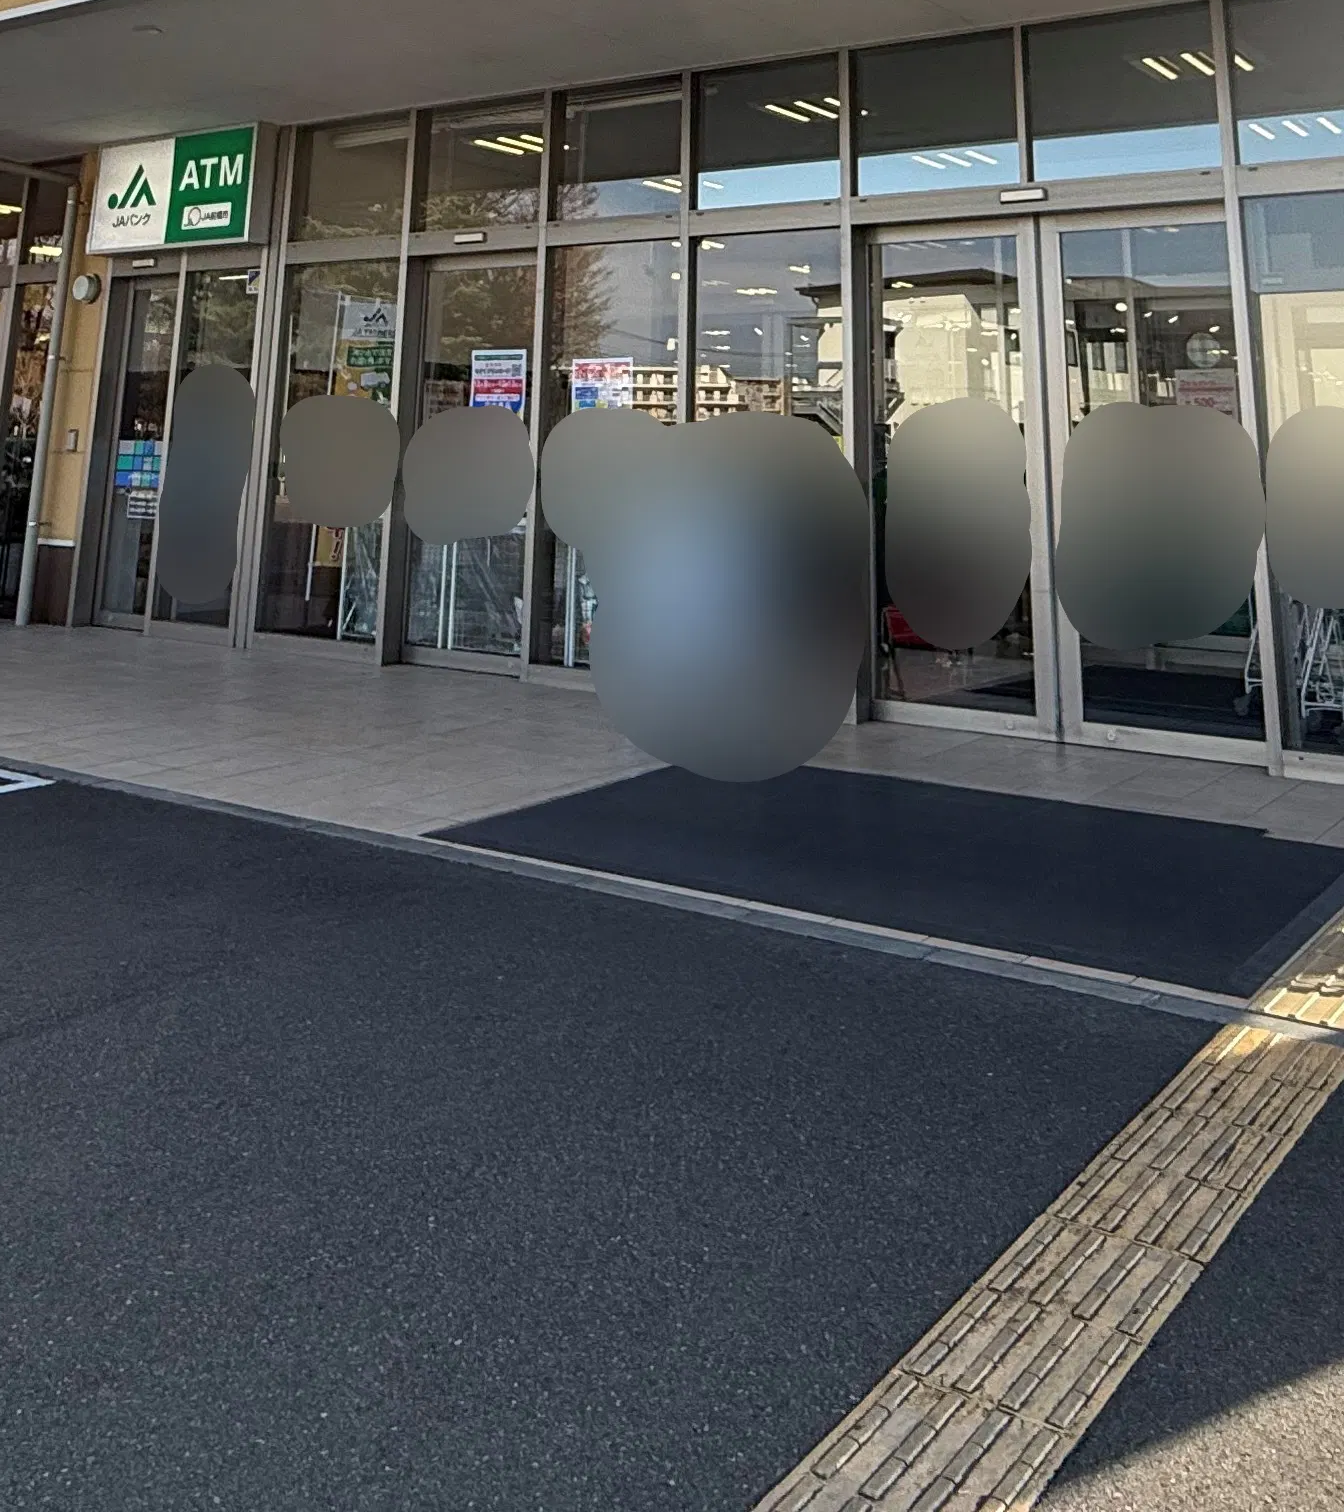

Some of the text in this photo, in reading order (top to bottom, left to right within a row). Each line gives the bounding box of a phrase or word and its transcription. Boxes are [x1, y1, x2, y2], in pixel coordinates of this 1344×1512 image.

[179, 154, 244, 191] ATM
[112, 212, 151, 227] JAバンク
